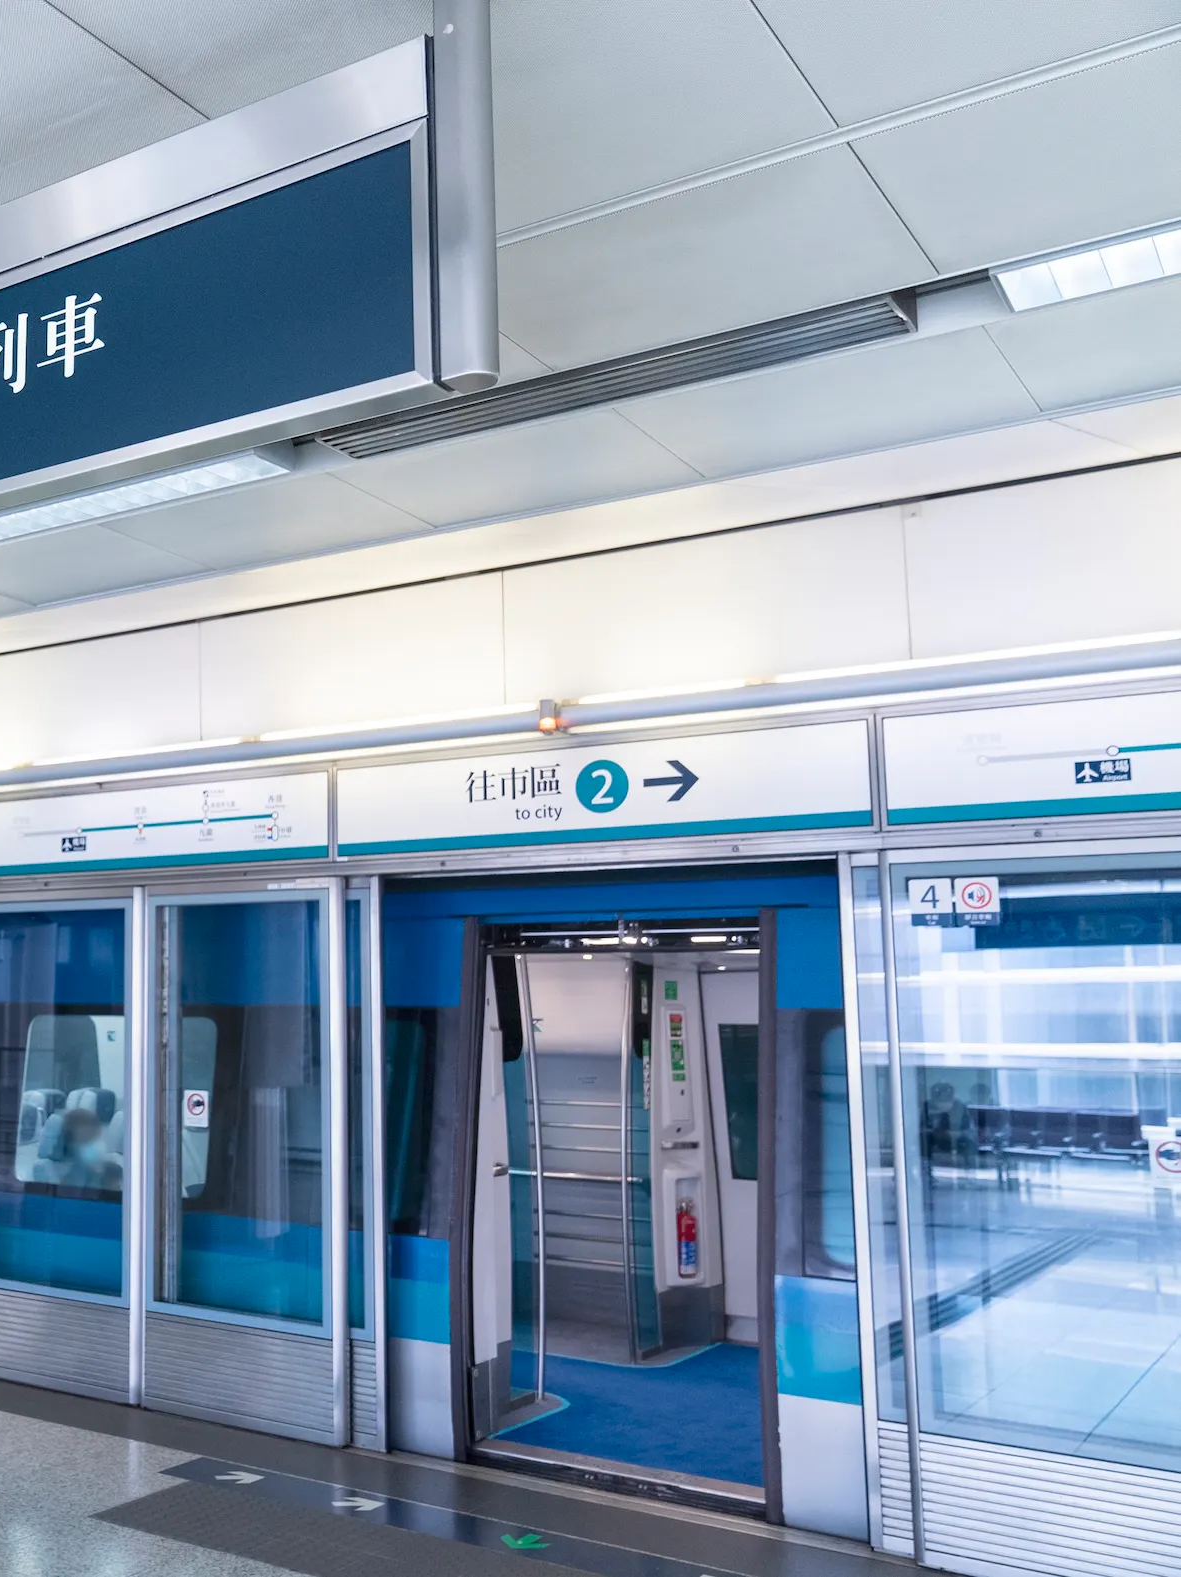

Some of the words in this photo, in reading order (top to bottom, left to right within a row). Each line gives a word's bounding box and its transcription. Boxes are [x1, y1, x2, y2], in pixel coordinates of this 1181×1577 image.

[465, 763, 563, 804] 往市區
[590, 767, 614, 805] 2
[515, 806, 530, 820] to
[535, 804, 563, 822] city
[920, 884, 940, 909] 4
